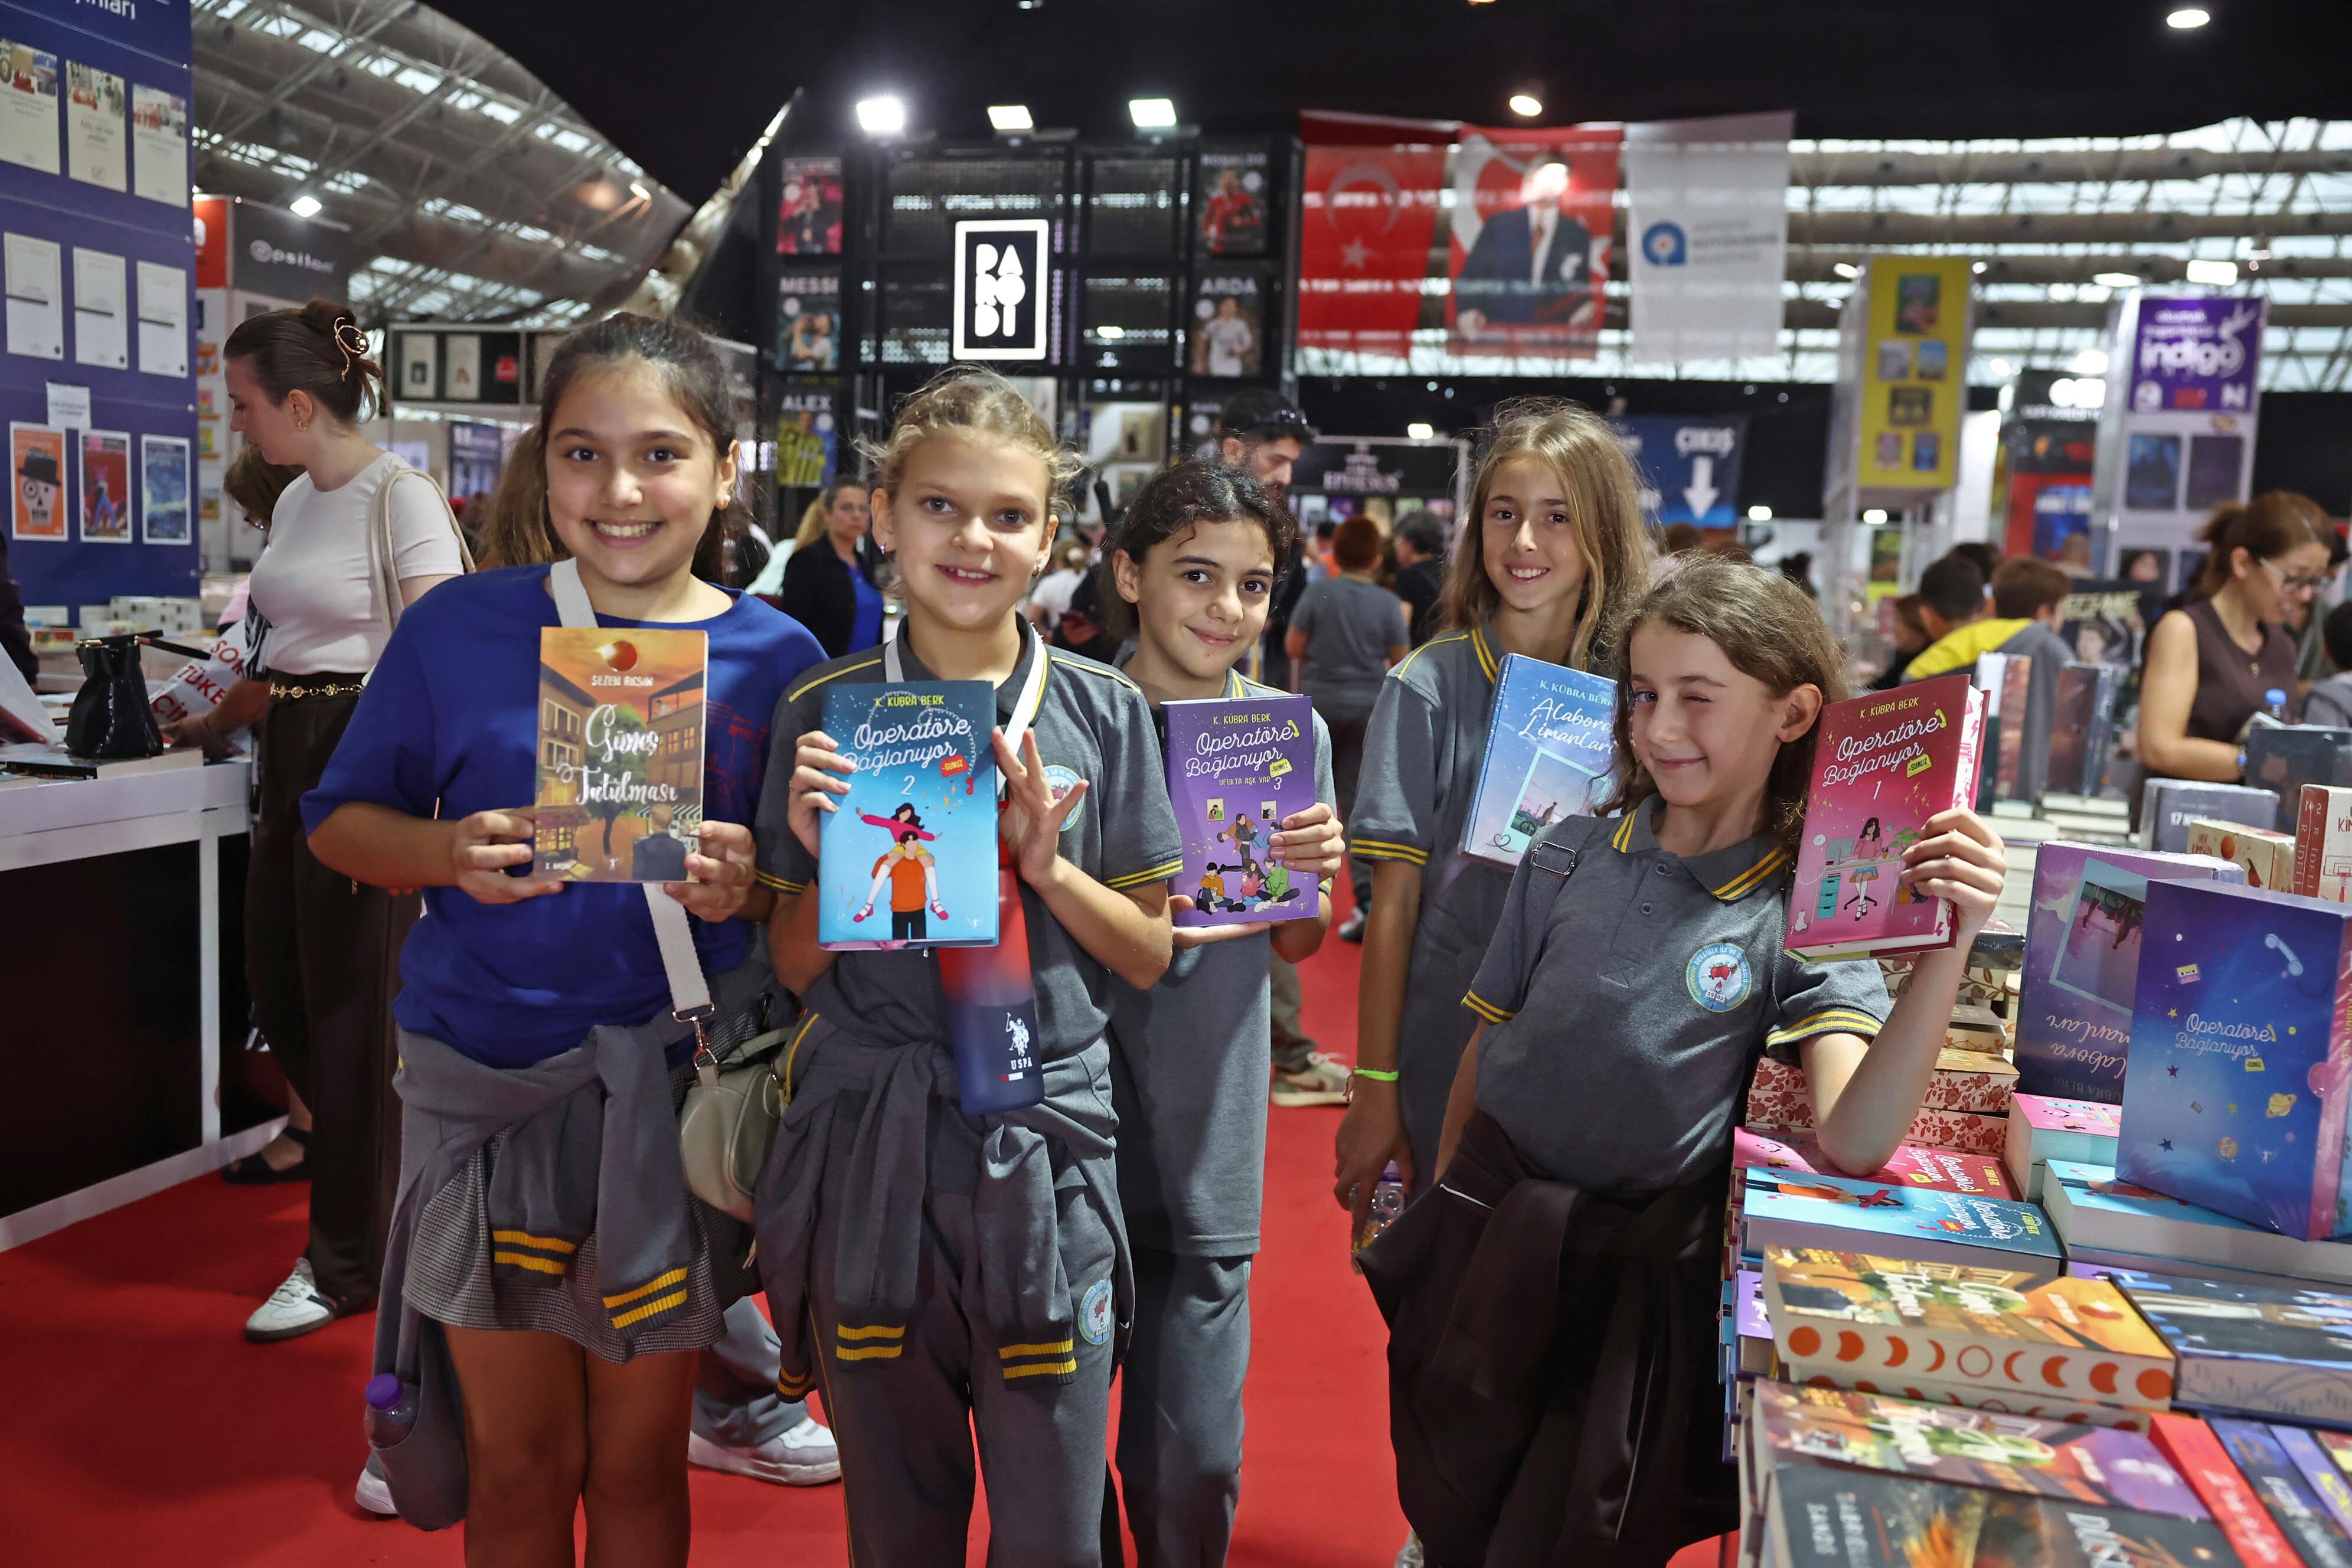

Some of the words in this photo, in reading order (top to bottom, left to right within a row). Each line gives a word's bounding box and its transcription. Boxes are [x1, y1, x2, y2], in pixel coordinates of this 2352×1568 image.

[887, 694, 917, 707] KÜBRA
[920, 695, 945, 706] BERK
[1540, 680, 1550, 690] K.
[1551, 682, 1586, 701] KÜBRA
[1213, 716, 1221, 725] K.
[1223, 713, 1249, 724] KÜBRA
[1252, 713, 1271, 723] BERK
[1530, 697, 1613, 733] Alabora
[1860, 709, 1867, 719] K.
[1870, 701, 1895, 717] KÜBRA
[1899, 697, 1920, 710] BERK
[854, 718, 972, 753] Operatöre
[1196, 726, 1294, 757] Operatöre
[1518, 715, 1615, 755] Limanları
[1837, 717, 1940, 762] Operatöre
[842, 741, 958, 777] Bağlanıyor
[1185, 747, 1283, 779] Bağlanıyor
[1822, 743, 1925, 788] Bağlanıyor
[556, 762, 678, 805] Tutulması
[901, 775, 916, 796] 2
[1219, 778, 1242, 786] UFUKTA
[1244, 777, 1257, 786] AŞK
[1273, 776, 1283, 790] 3
[1873, 780, 1882, 801] 1
[2186, 1012, 2273, 1042] Operatöre
[2050, 1043, 2126, 1079] labora
[2175, 1032, 2259, 1061] Bağlanıyor
[1010, 1056, 1033, 1070] USPA
